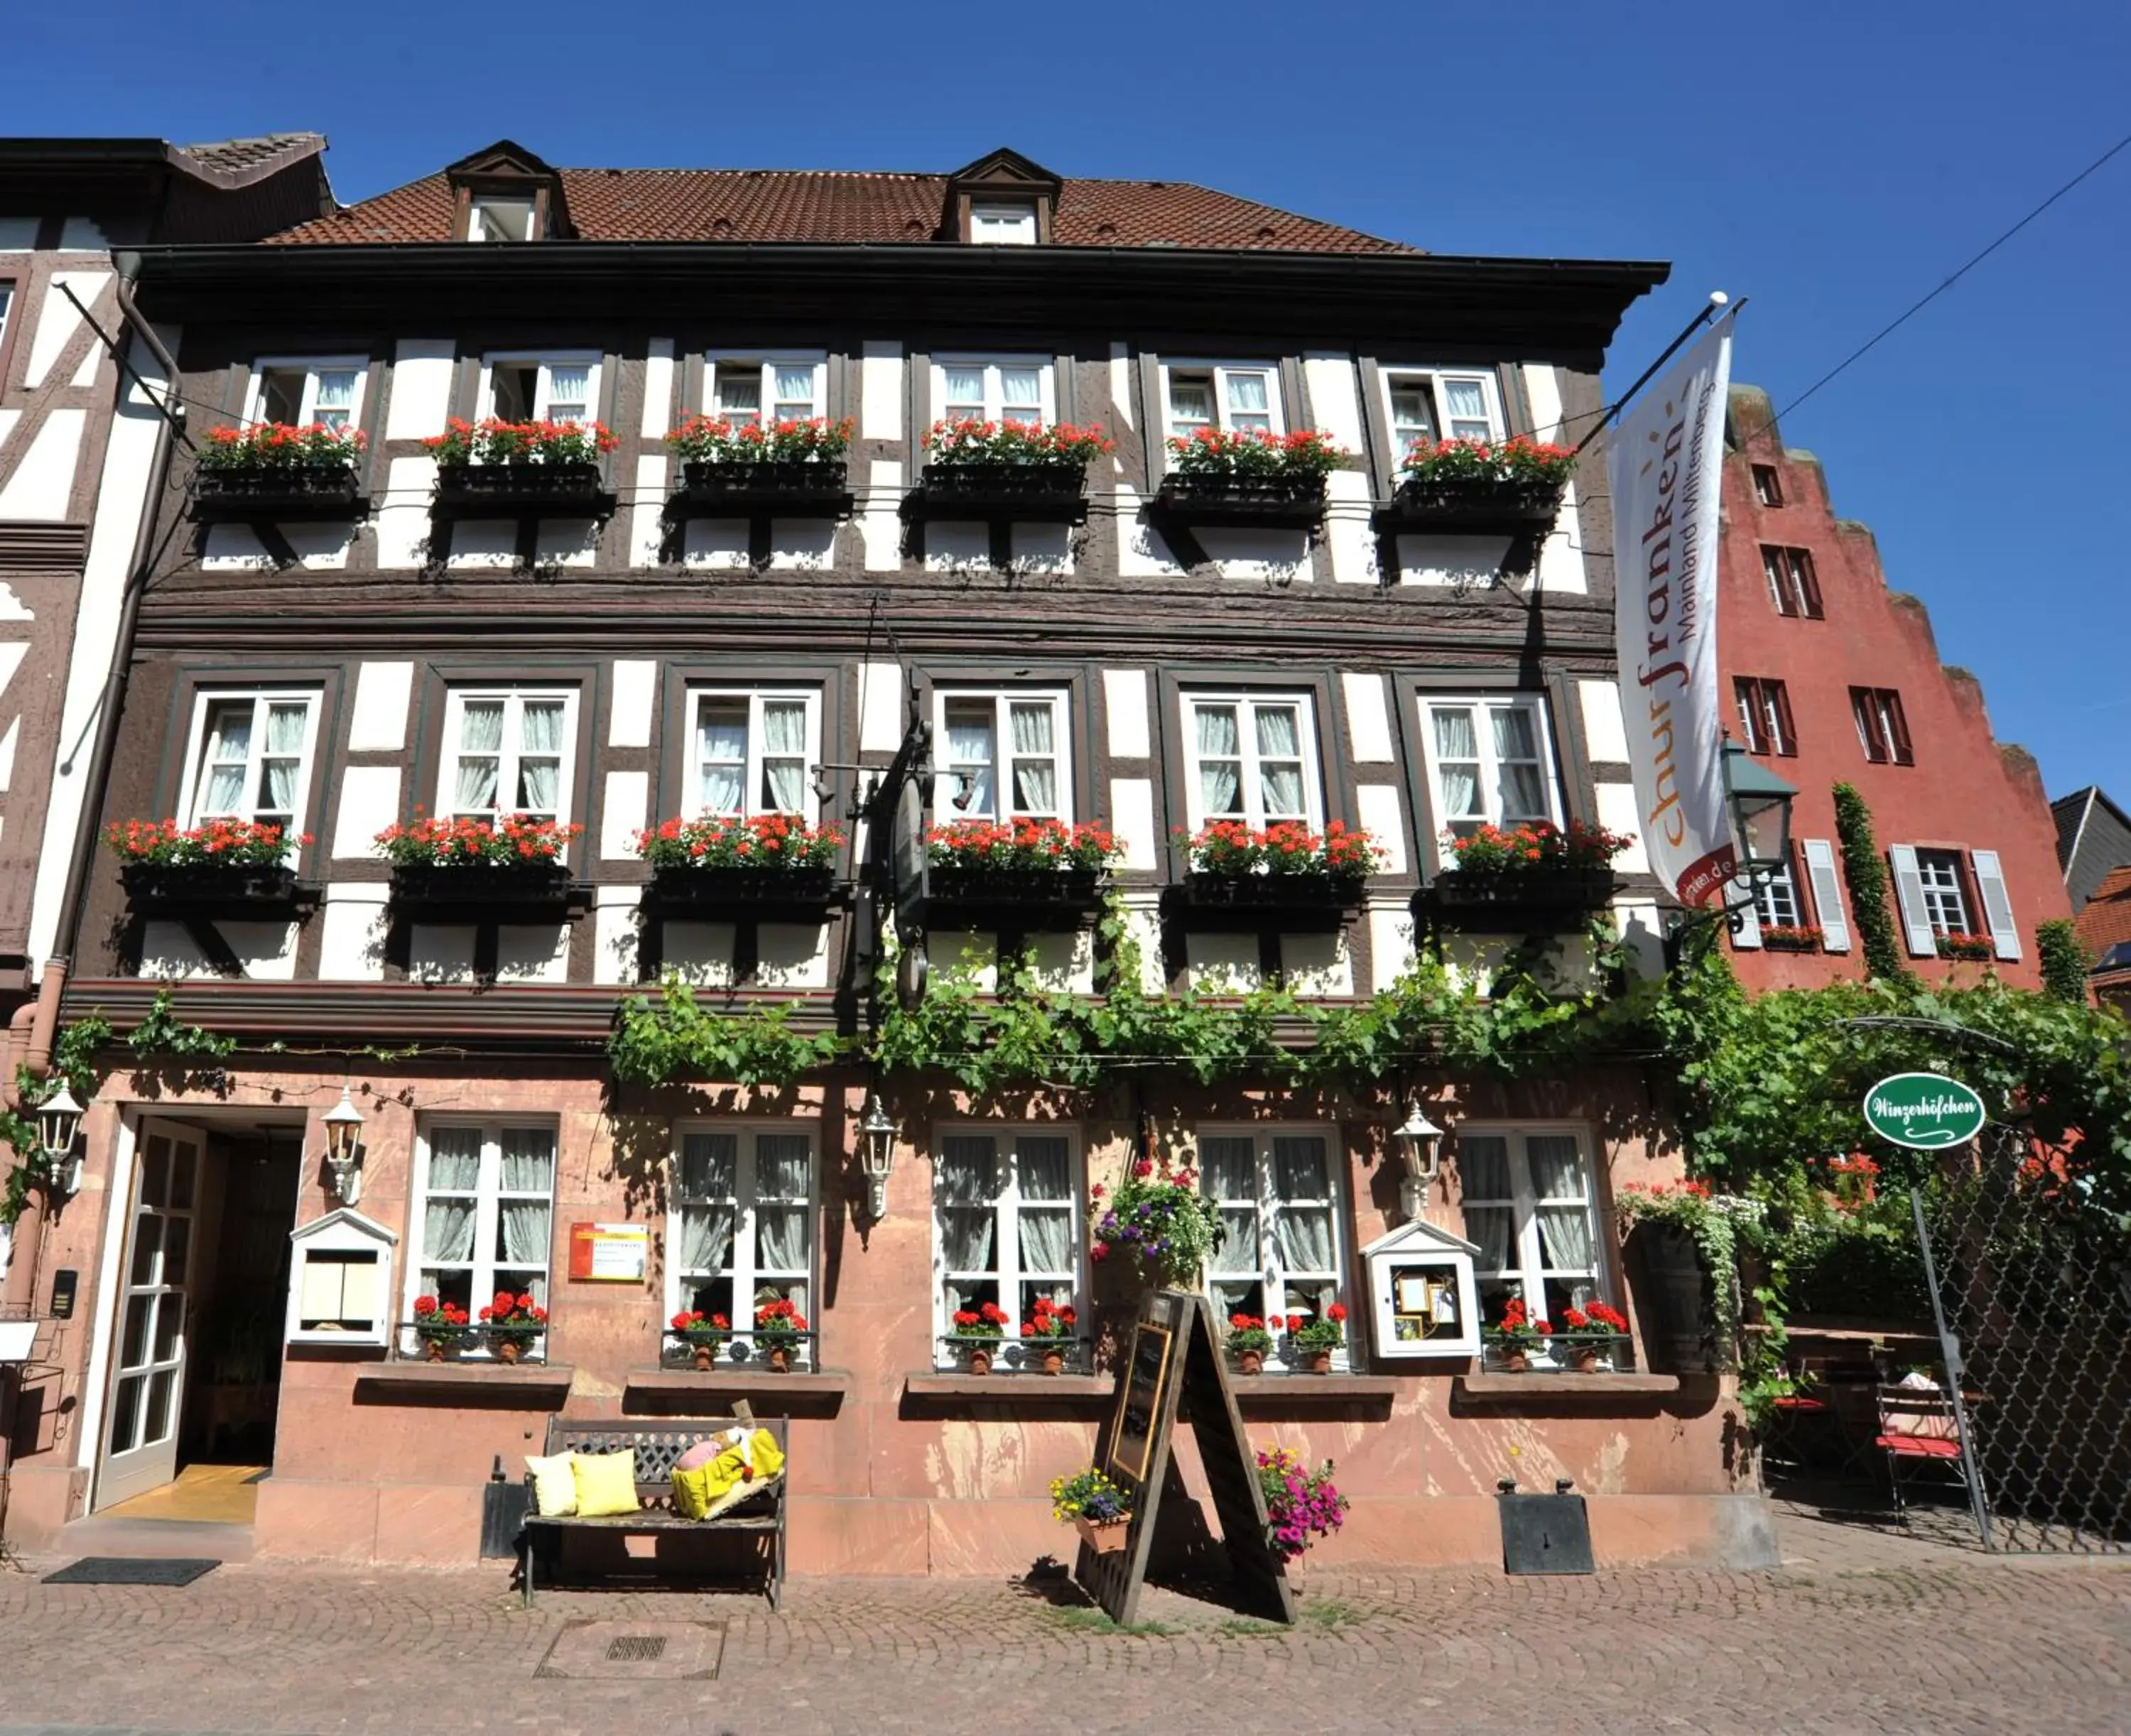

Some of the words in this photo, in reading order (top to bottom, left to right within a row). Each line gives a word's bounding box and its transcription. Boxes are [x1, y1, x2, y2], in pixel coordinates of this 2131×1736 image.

[1680, 381, 1716, 520] Miltenberg
[1637, 416, 1690, 847] churfranken
[1677, 521, 1697, 644] Mainland
[1872, 1095, 1976, 1126] Winzerhöfchen
